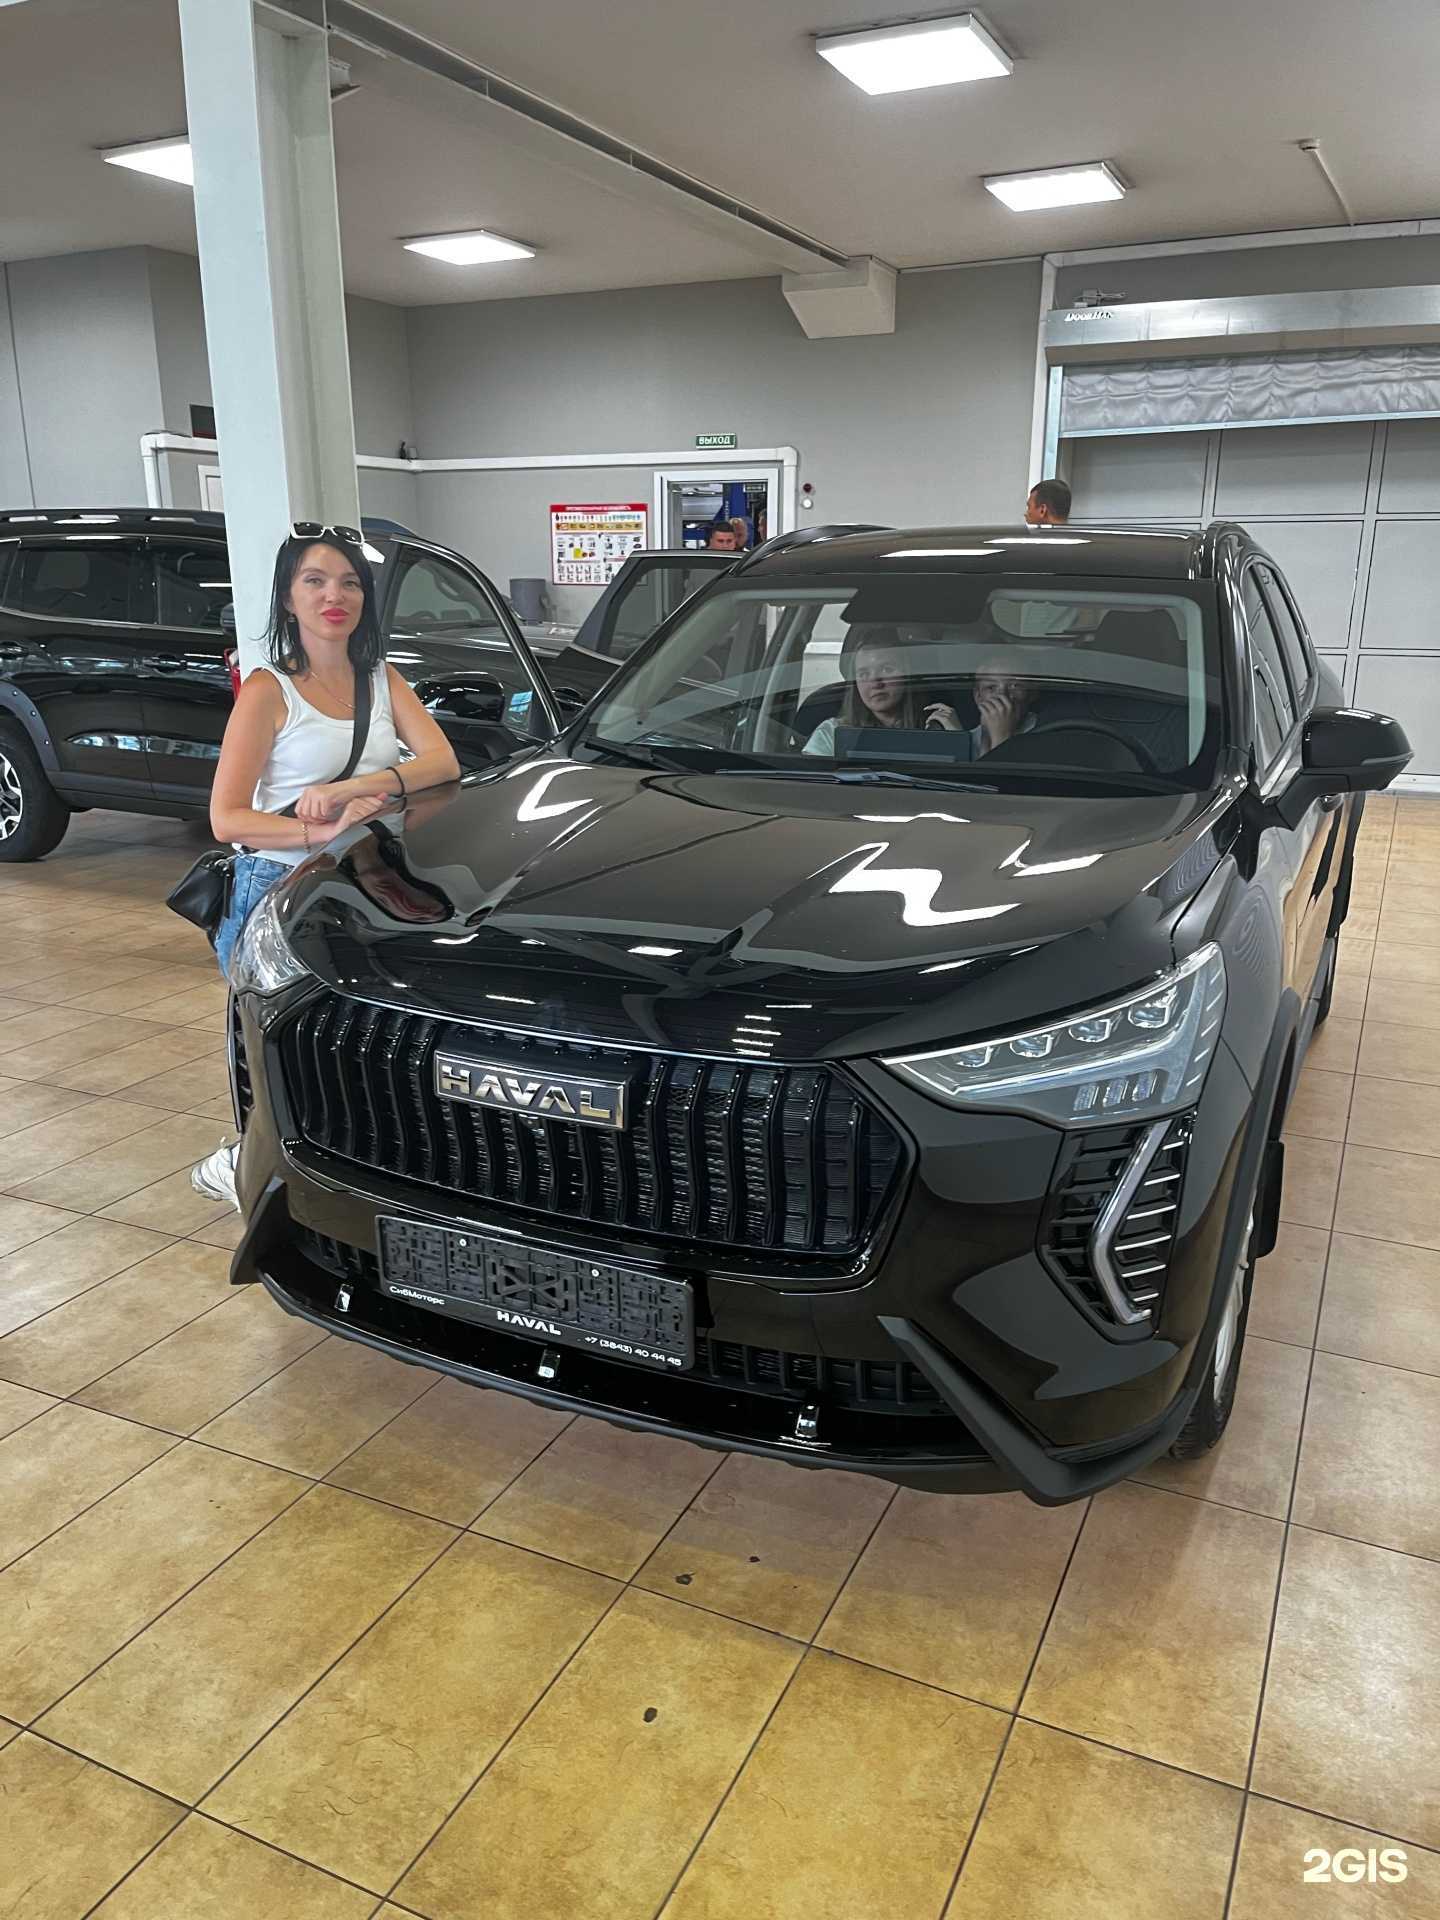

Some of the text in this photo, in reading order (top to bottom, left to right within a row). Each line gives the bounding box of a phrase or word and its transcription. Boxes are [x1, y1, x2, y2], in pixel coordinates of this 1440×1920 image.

[698, 436, 731, 445] ВЫХОД
[440, 1064, 611, 1119] HAVAL
[389, 1286, 445, 1305] СибМоторс
[496, 1310, 562, 1336] HAVAL
[584, 1336, 598, 1344] +7
[599, 1338, 633, 1354] (3843)
[634, 1348, 650, 1358] 40
[650, 1352, 666, 1362] 44
